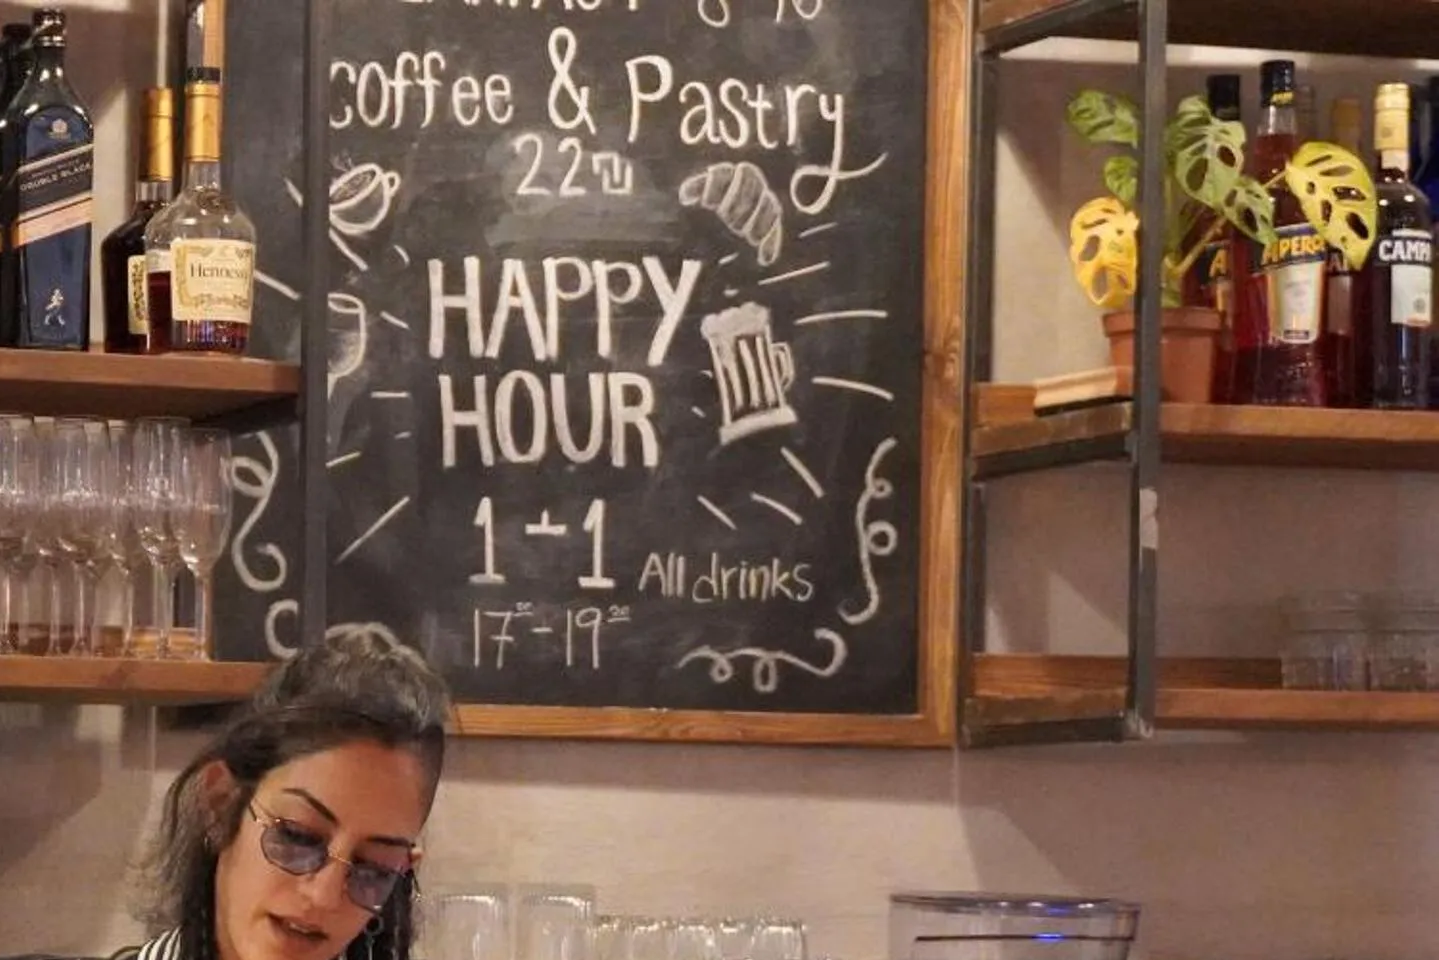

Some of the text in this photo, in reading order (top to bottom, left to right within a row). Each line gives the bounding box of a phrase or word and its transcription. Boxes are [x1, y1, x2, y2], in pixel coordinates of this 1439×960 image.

[548, 26, 596, 135] &
[626, 54, 888, 214] Pastry
[428, 256, 702, 366] HAPPY
[439, 369, 659, 468] HOUR
[639, 552, 814, 602] All drinks
